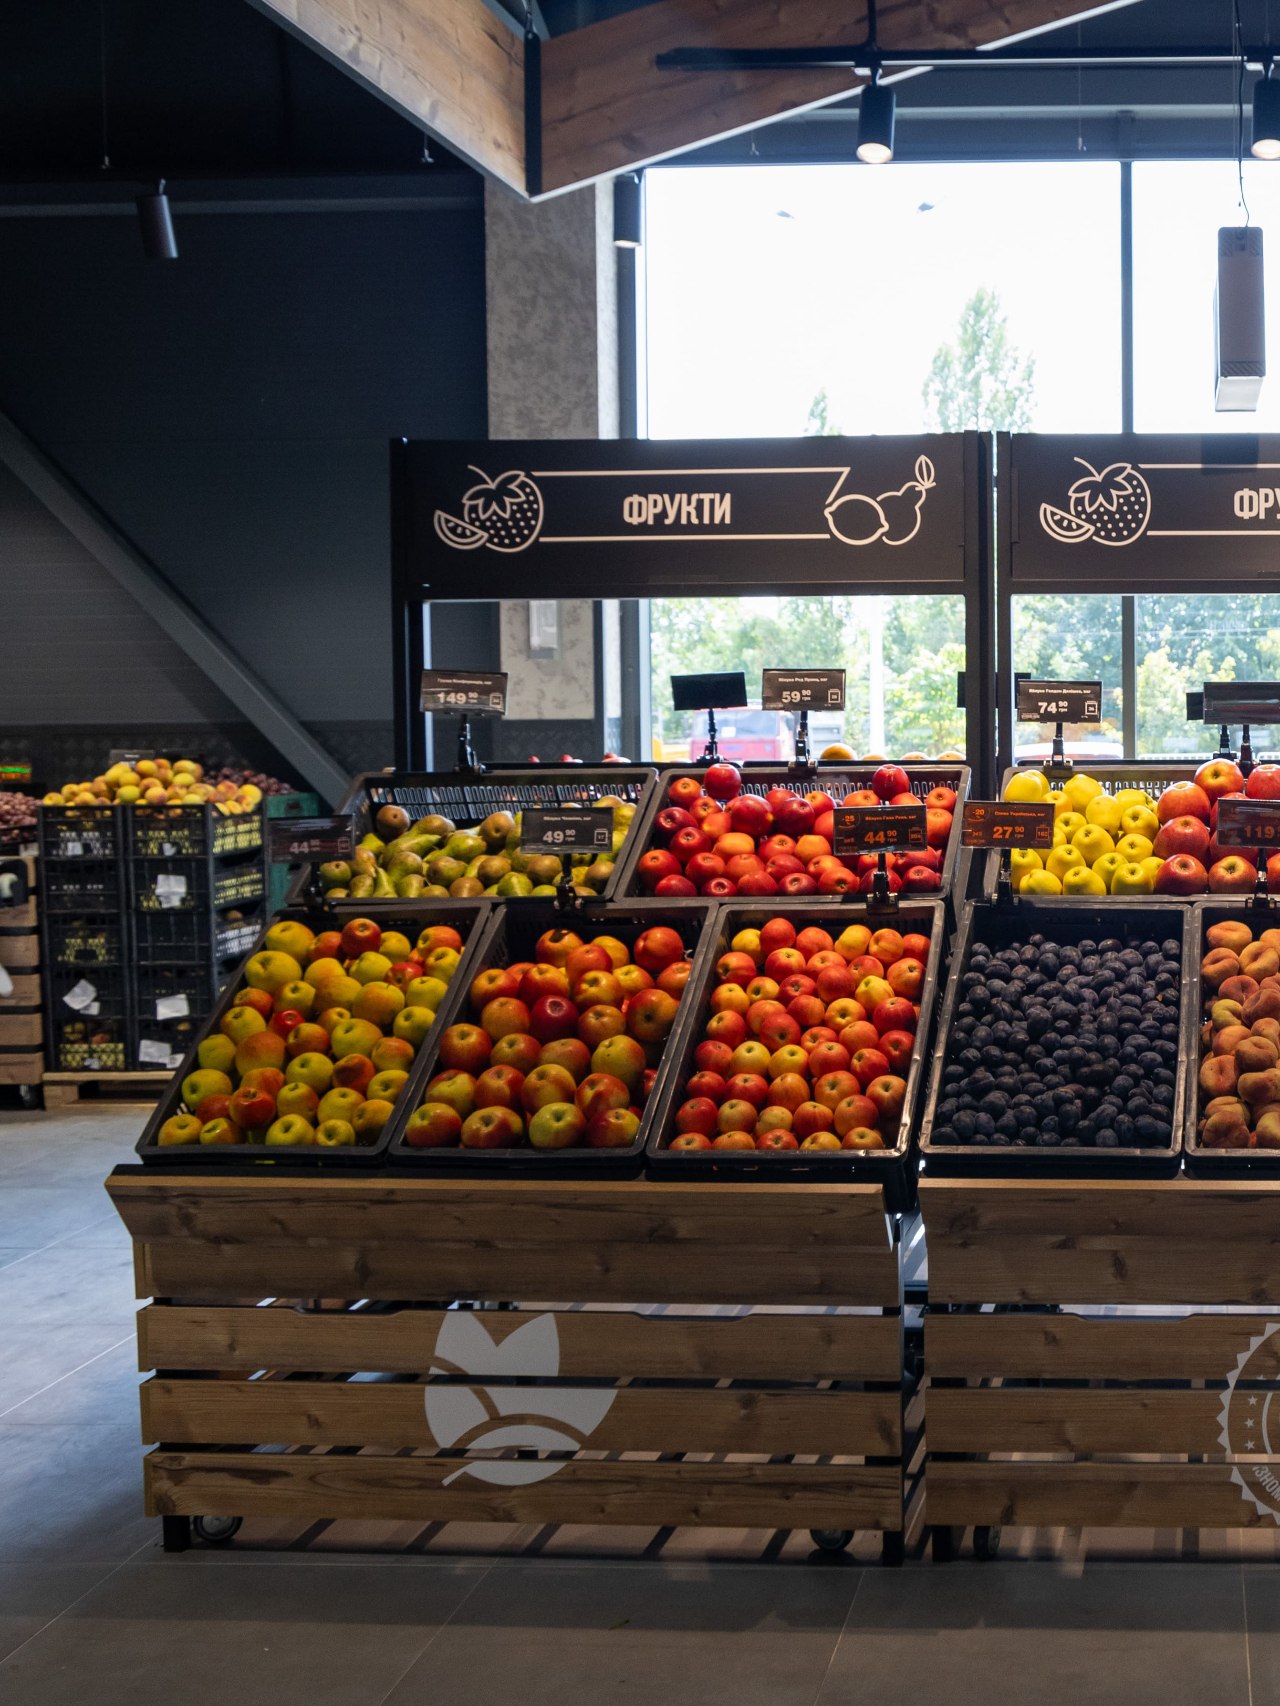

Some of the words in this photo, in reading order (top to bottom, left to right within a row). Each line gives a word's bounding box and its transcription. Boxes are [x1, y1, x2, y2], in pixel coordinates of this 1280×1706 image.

[623, 493, 731, 525] ФРУКТИ
[437, 692, 466, 704] 149
[782, 691, 800, 702] 59
[1038, 702, 1057, 713] 74
[543, 831, 564, 843] 49
[864, 831, 885, 844] 44
[993, 826, 1013, 838] 27
[1244, 825, 1275, 838] 119
[290, 842, 309, 853] 44
